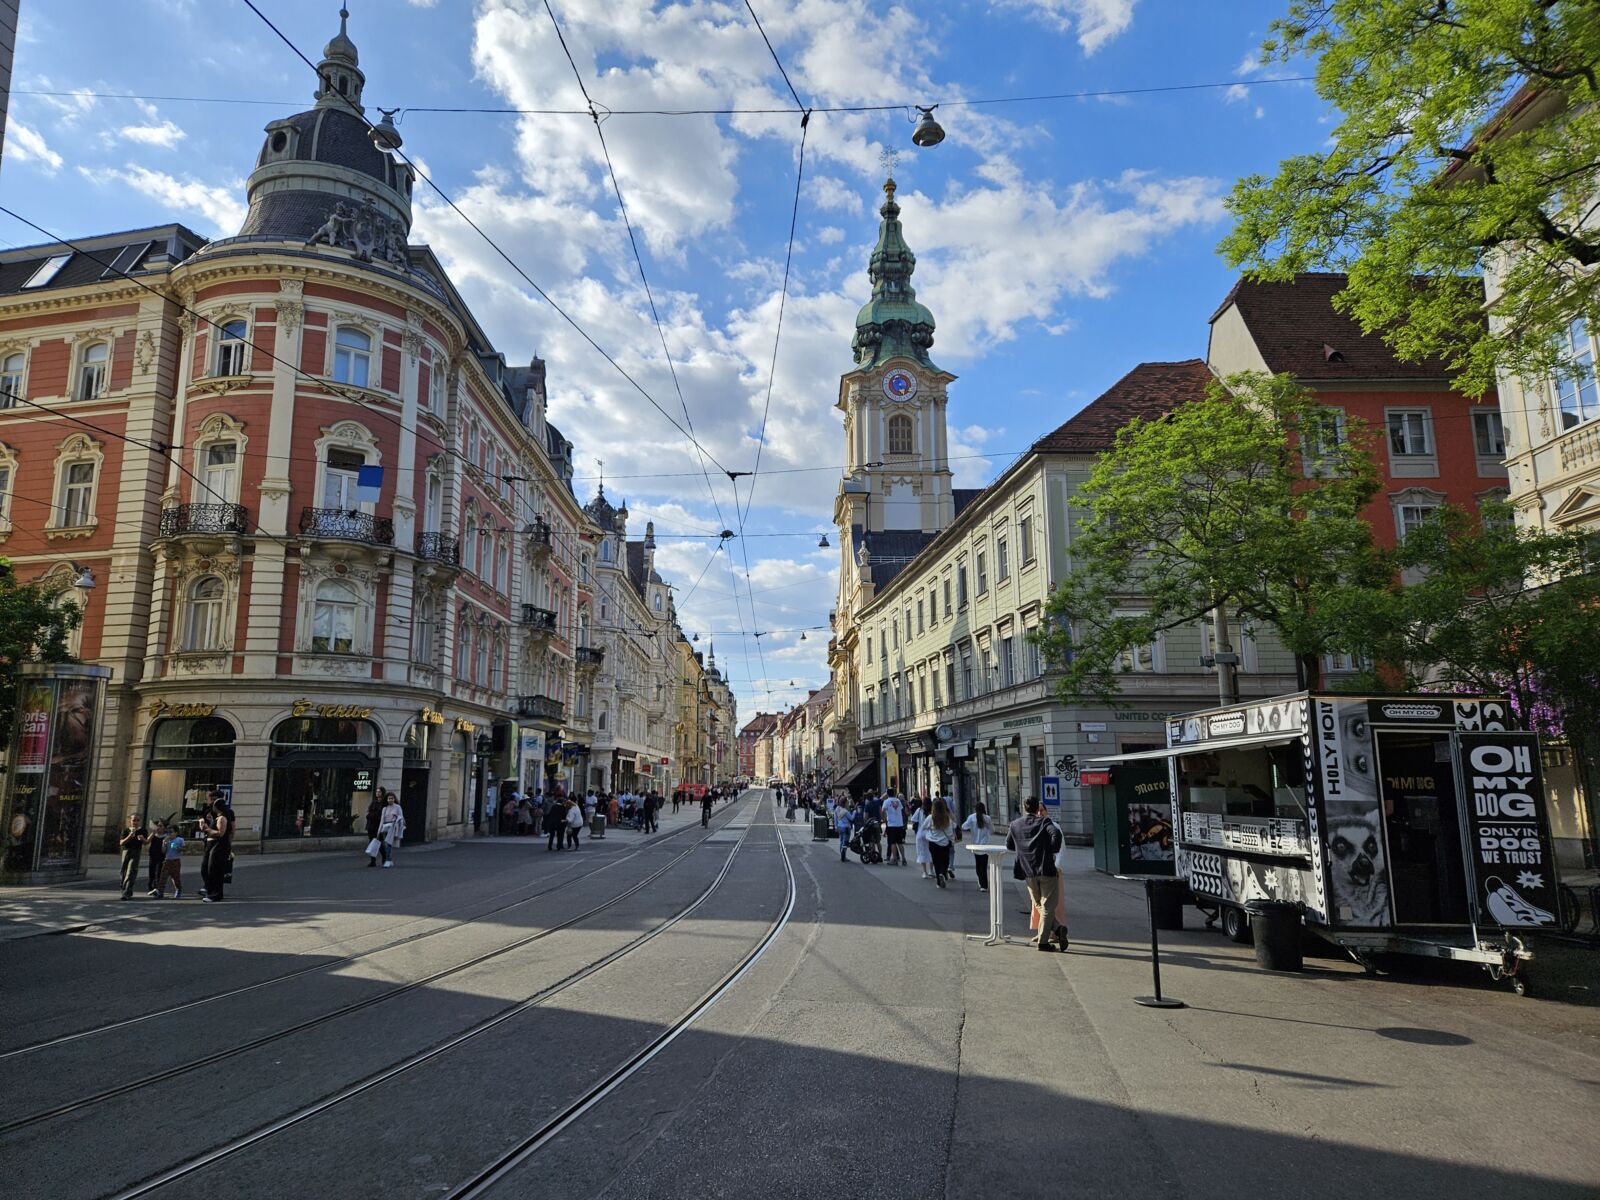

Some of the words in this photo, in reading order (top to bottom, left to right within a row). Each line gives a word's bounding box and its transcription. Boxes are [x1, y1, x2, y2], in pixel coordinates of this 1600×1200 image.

[317, 703, 374, 719] Tchibo
[1114, 712, 1149, 720] UNITED
[1213, 723, 1220, 731] OH
[1220, 722, 1229, 730] MY
[1229, 720, 1241, 729] DOG
[1320, 701, 1336, 741] MOLY
[1470, 745, 1532, 773] OH
[1324, 745, 1341, 794] HOLY
[1472, 776, 1534, 790] MY
[1474, 792, 1536, 817] DOG
[1479, 827, 1521, 837] ONLY
[1523, 828, 1538, 837] IN
[1480, 837, 1541, 850] DOG
[1481, 851, 1504, 864] WE
[1505, 851, 1542, 865] TRUST
